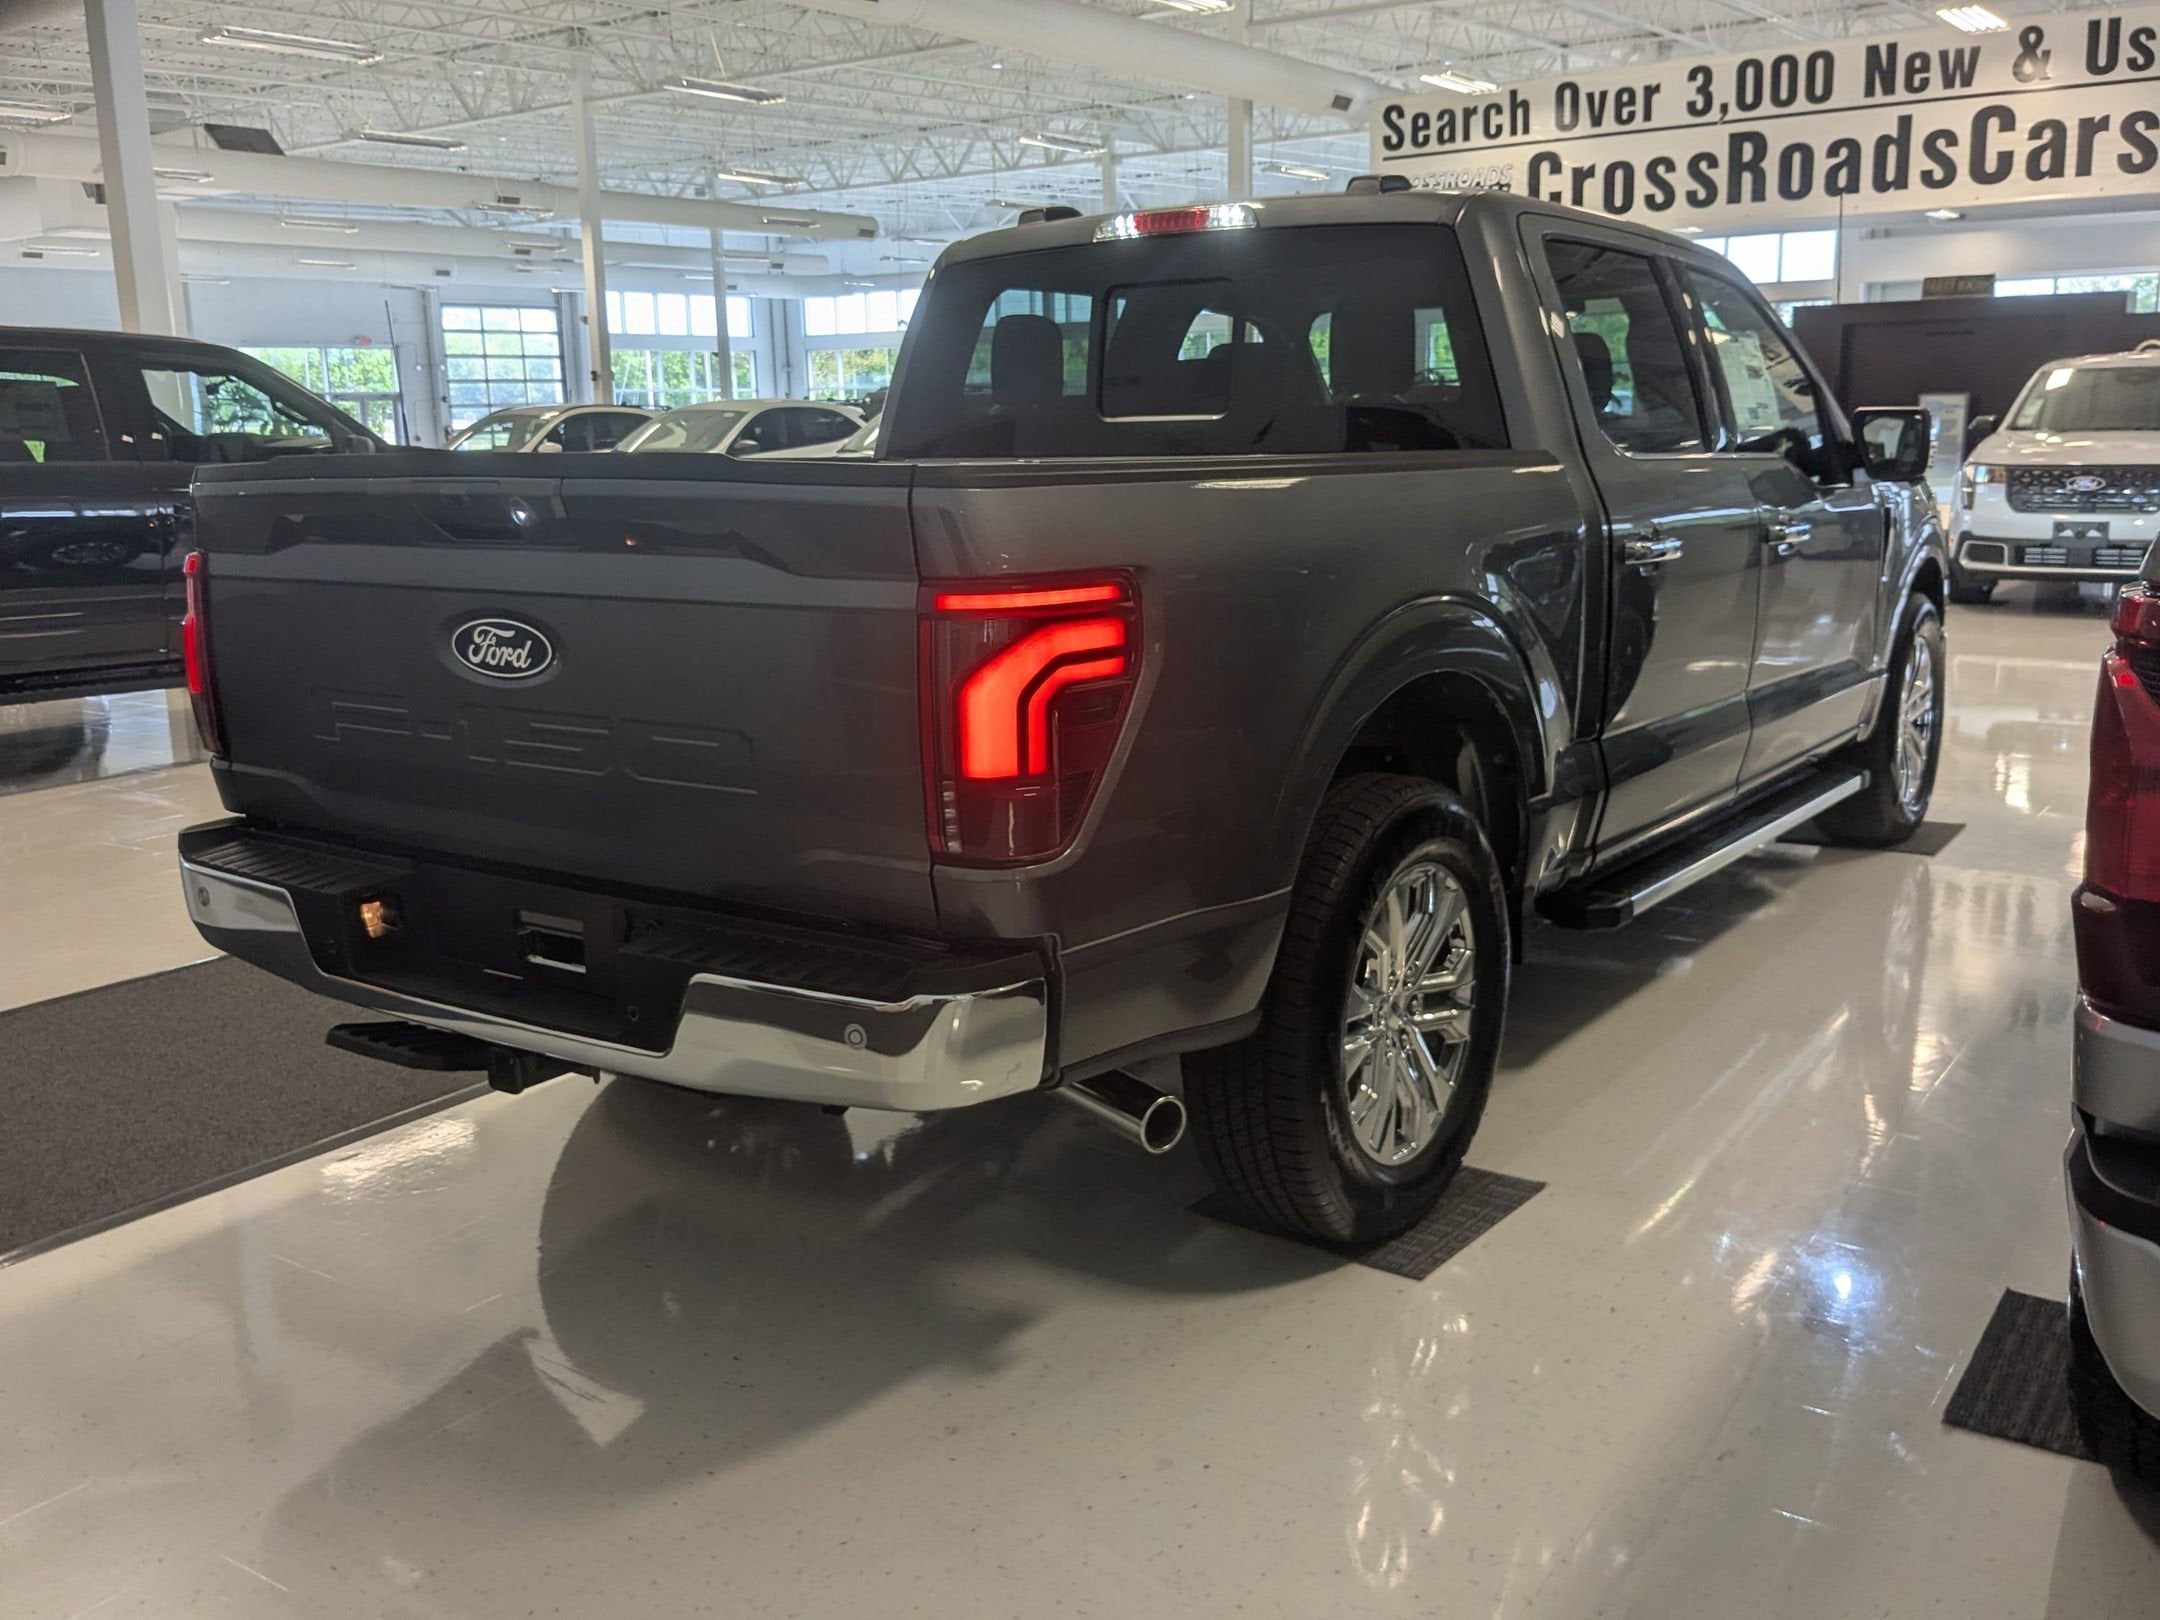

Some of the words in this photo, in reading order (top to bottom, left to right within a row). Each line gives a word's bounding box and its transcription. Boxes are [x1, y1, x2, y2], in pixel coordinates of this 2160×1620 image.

[1382, 87, 1531, 152] Search
[1554, 81, 1661, 133] Over
[1686, 49, 1836, 121] 3,000
[1863, 42, 1982, 99] New
[2011, 24, 2053, 84] &
[1527, 104, 2160, 215] CrossRoadsCars
[468, 625, 533, 669] Ford
